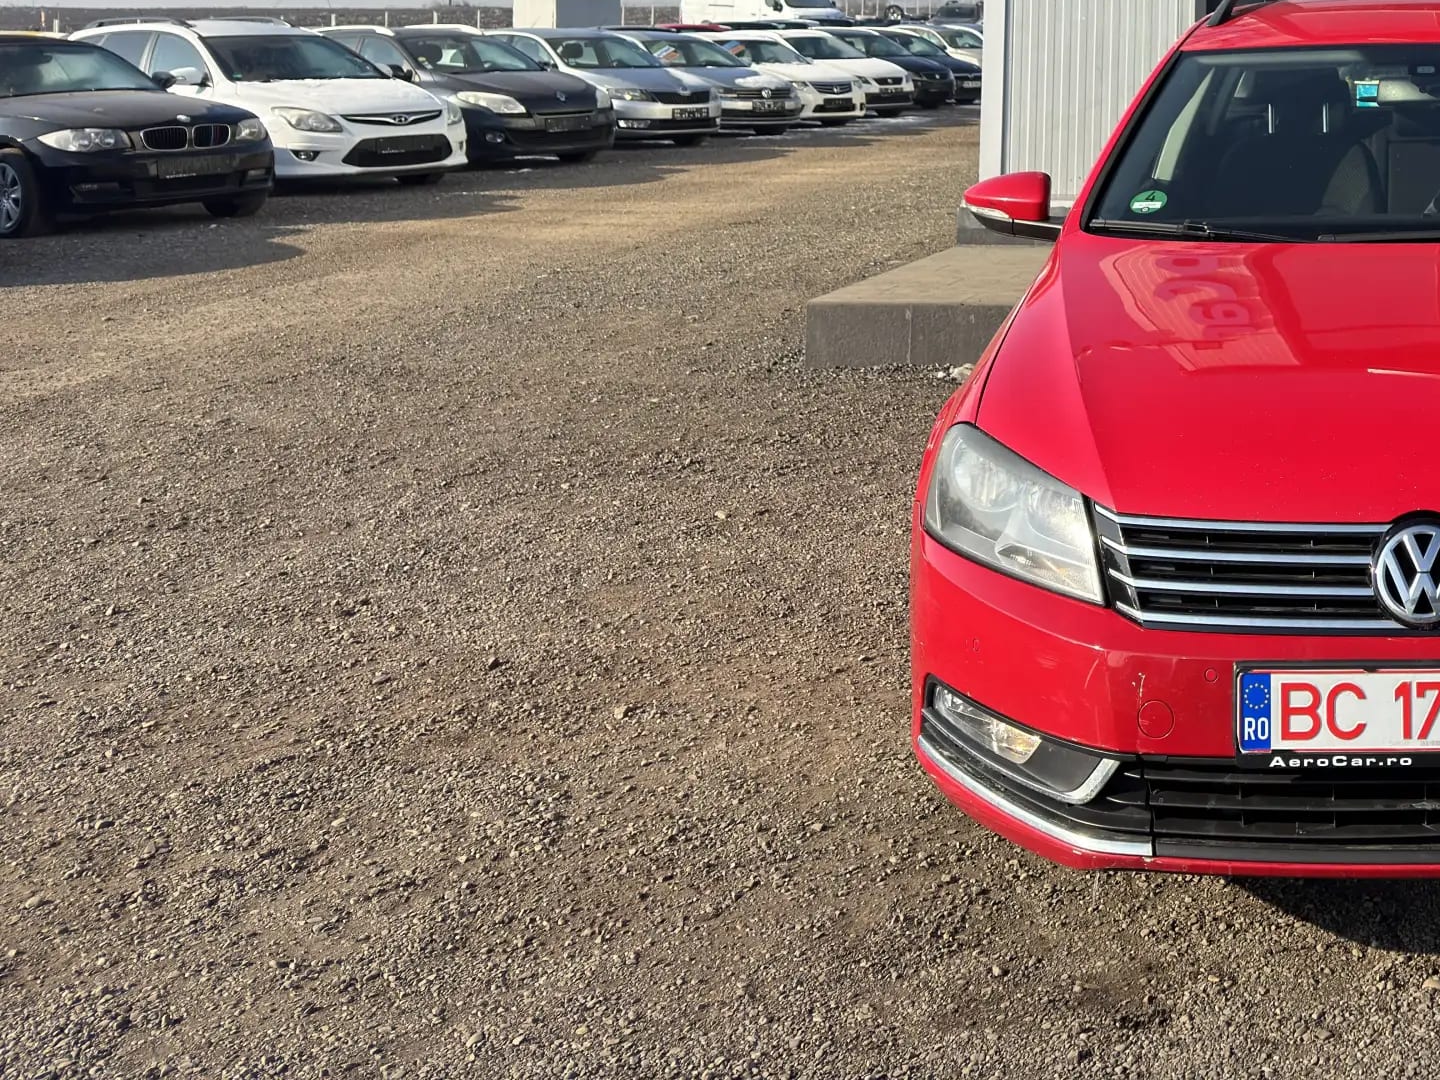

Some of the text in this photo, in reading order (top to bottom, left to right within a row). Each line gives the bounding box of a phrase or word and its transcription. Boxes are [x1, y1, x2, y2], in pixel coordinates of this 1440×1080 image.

[1145, 191, 1156, 202] 4
[1280, 682, 1368, 741] BC
[1243, 716, 1269, 741] RO
[1268, 755, 1413, 768] AeroCar.ro
